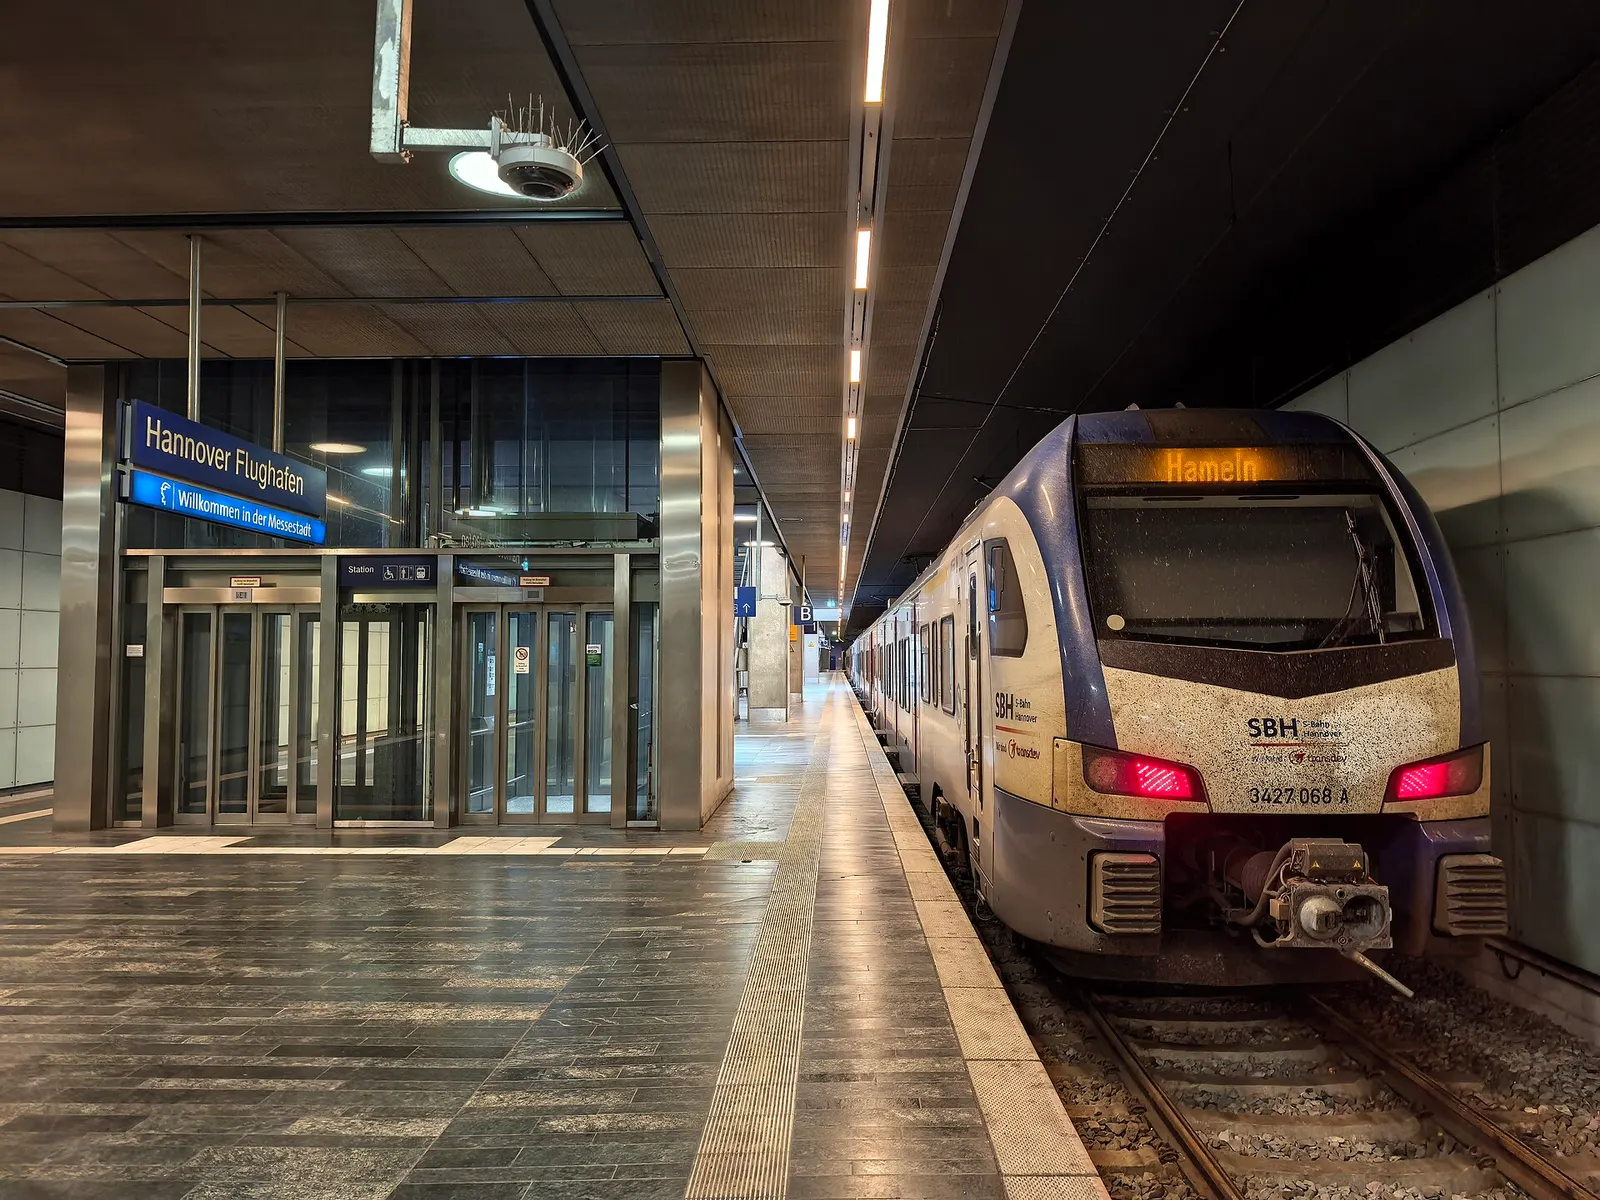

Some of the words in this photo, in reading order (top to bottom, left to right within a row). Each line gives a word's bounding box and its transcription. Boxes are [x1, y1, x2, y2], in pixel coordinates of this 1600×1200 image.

[146, 416, 232, 471] Hannover
[235, 448, 304, 496] Flughafen
[1167, 451, 1257, 482] Hameln
[178, 489, 240, 520] Willkommen
[242, 506, 251, 522] in
[252, 509, 267, 526] der
[268, 514, 312, 538] Messestadt
[348, 565, 375, 574] Station
[800, 606, 811, 621] B
[995, 691, 1014, 720] SBH
[1014, 711, 1038, 723] Hannover
[1302, 719, 1330, 728] S-Bahn
[1247, 717, 1299, 738] SBH
[1303, 730, 1342, 738] Hannover
[1016, 745, 1041, 760] transdev
[1307, 753, 1348, 763] transdev
[1249, 787, 1295, 804] 3427
[1299, 786, 1332, 804] 068
[1340, 787, 1349, 804] A
